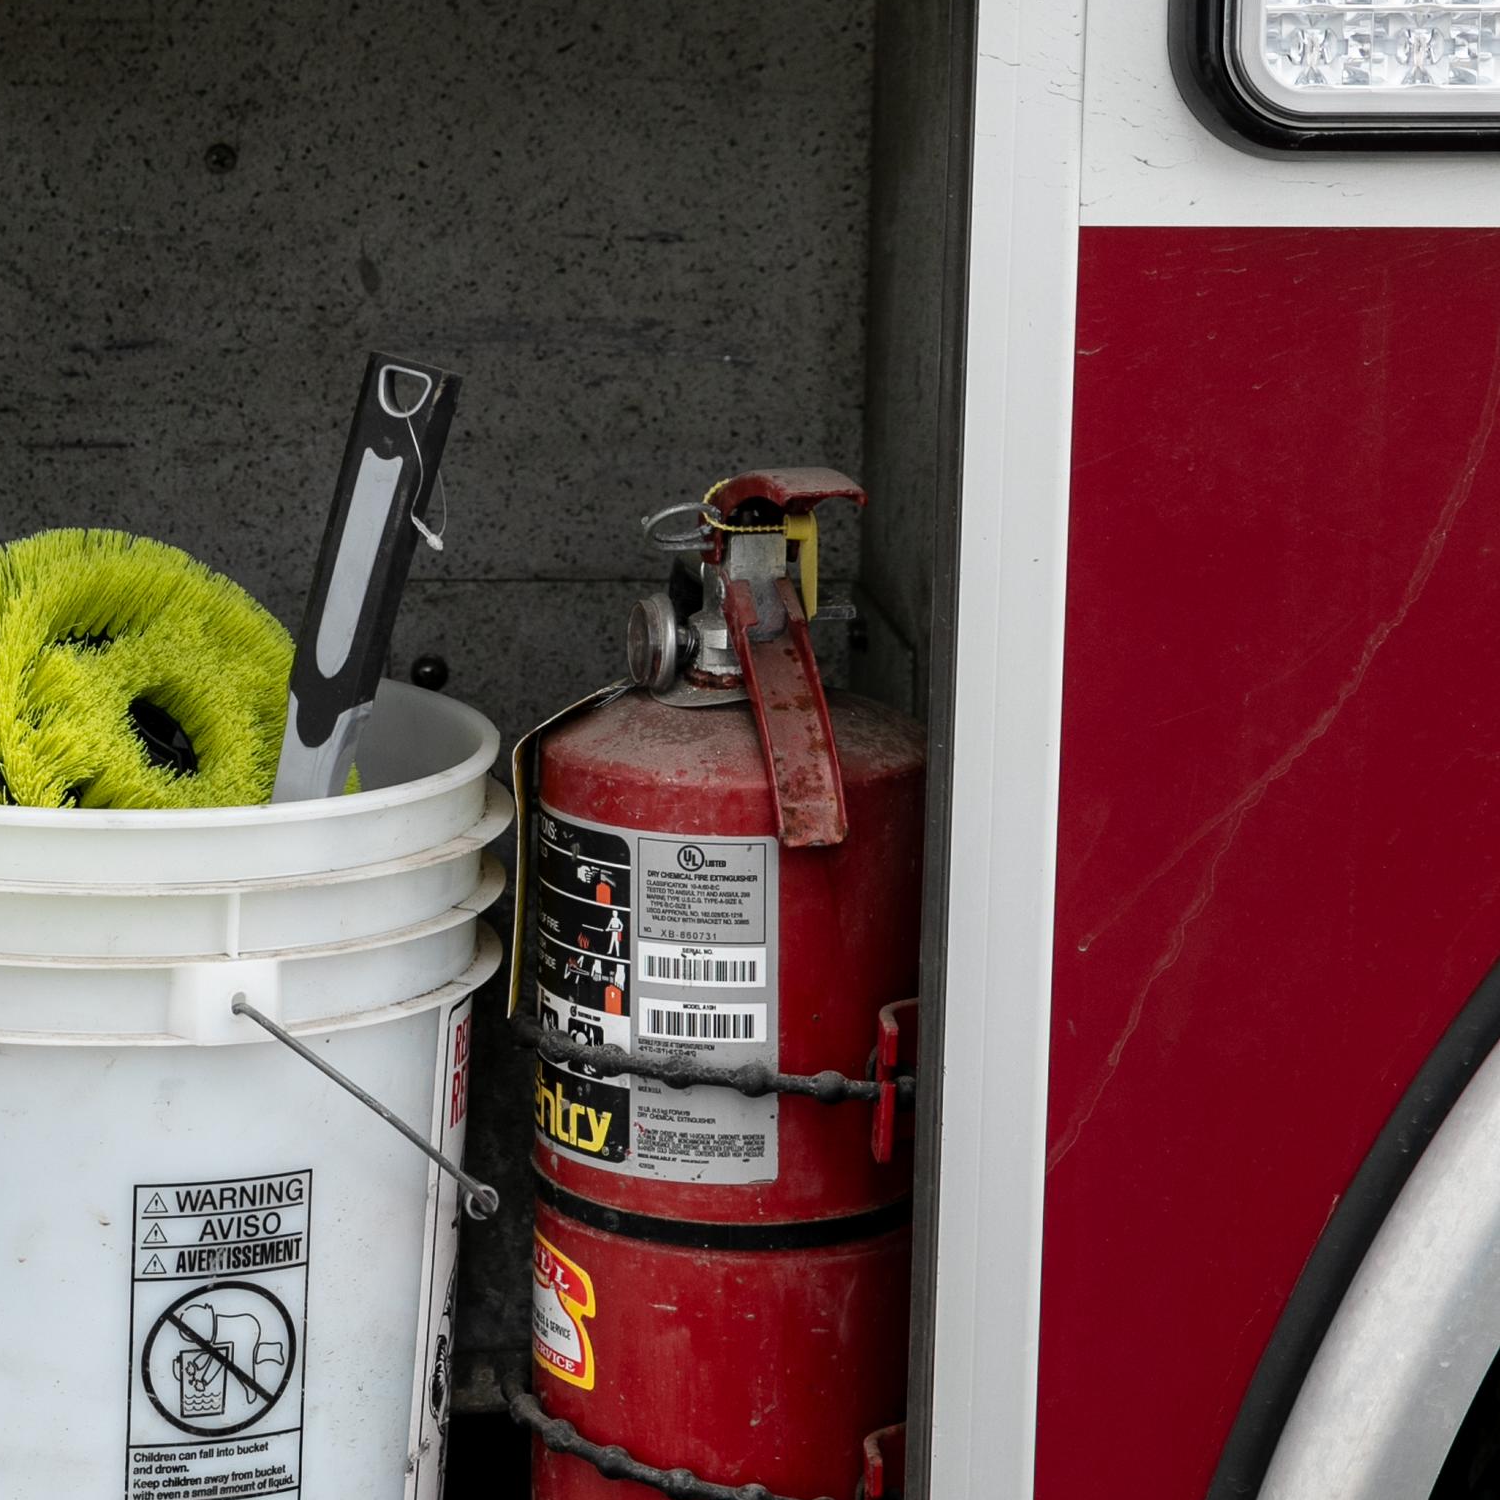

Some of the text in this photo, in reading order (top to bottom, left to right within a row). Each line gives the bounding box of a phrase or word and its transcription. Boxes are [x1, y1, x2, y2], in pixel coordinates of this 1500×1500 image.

[646, 880, 688, 889] CLASSIFICATION
[660, 871, 693, 880] CHEMICAL
[176, 1178, 303, 1212] WARNING
[198, 1212, 281, 1242] AVISO
[175, 1238, 302, 1273] AVERTISSEMENT
[134, 1442, 269, 1463] Children can fall into bucket
[133, 1463, 189, 1474] and drown.
[133, 1465, 286, 1490] Keep children away from bucket
[133, 1474, 294, 1500] with even a small amount of liquid.
